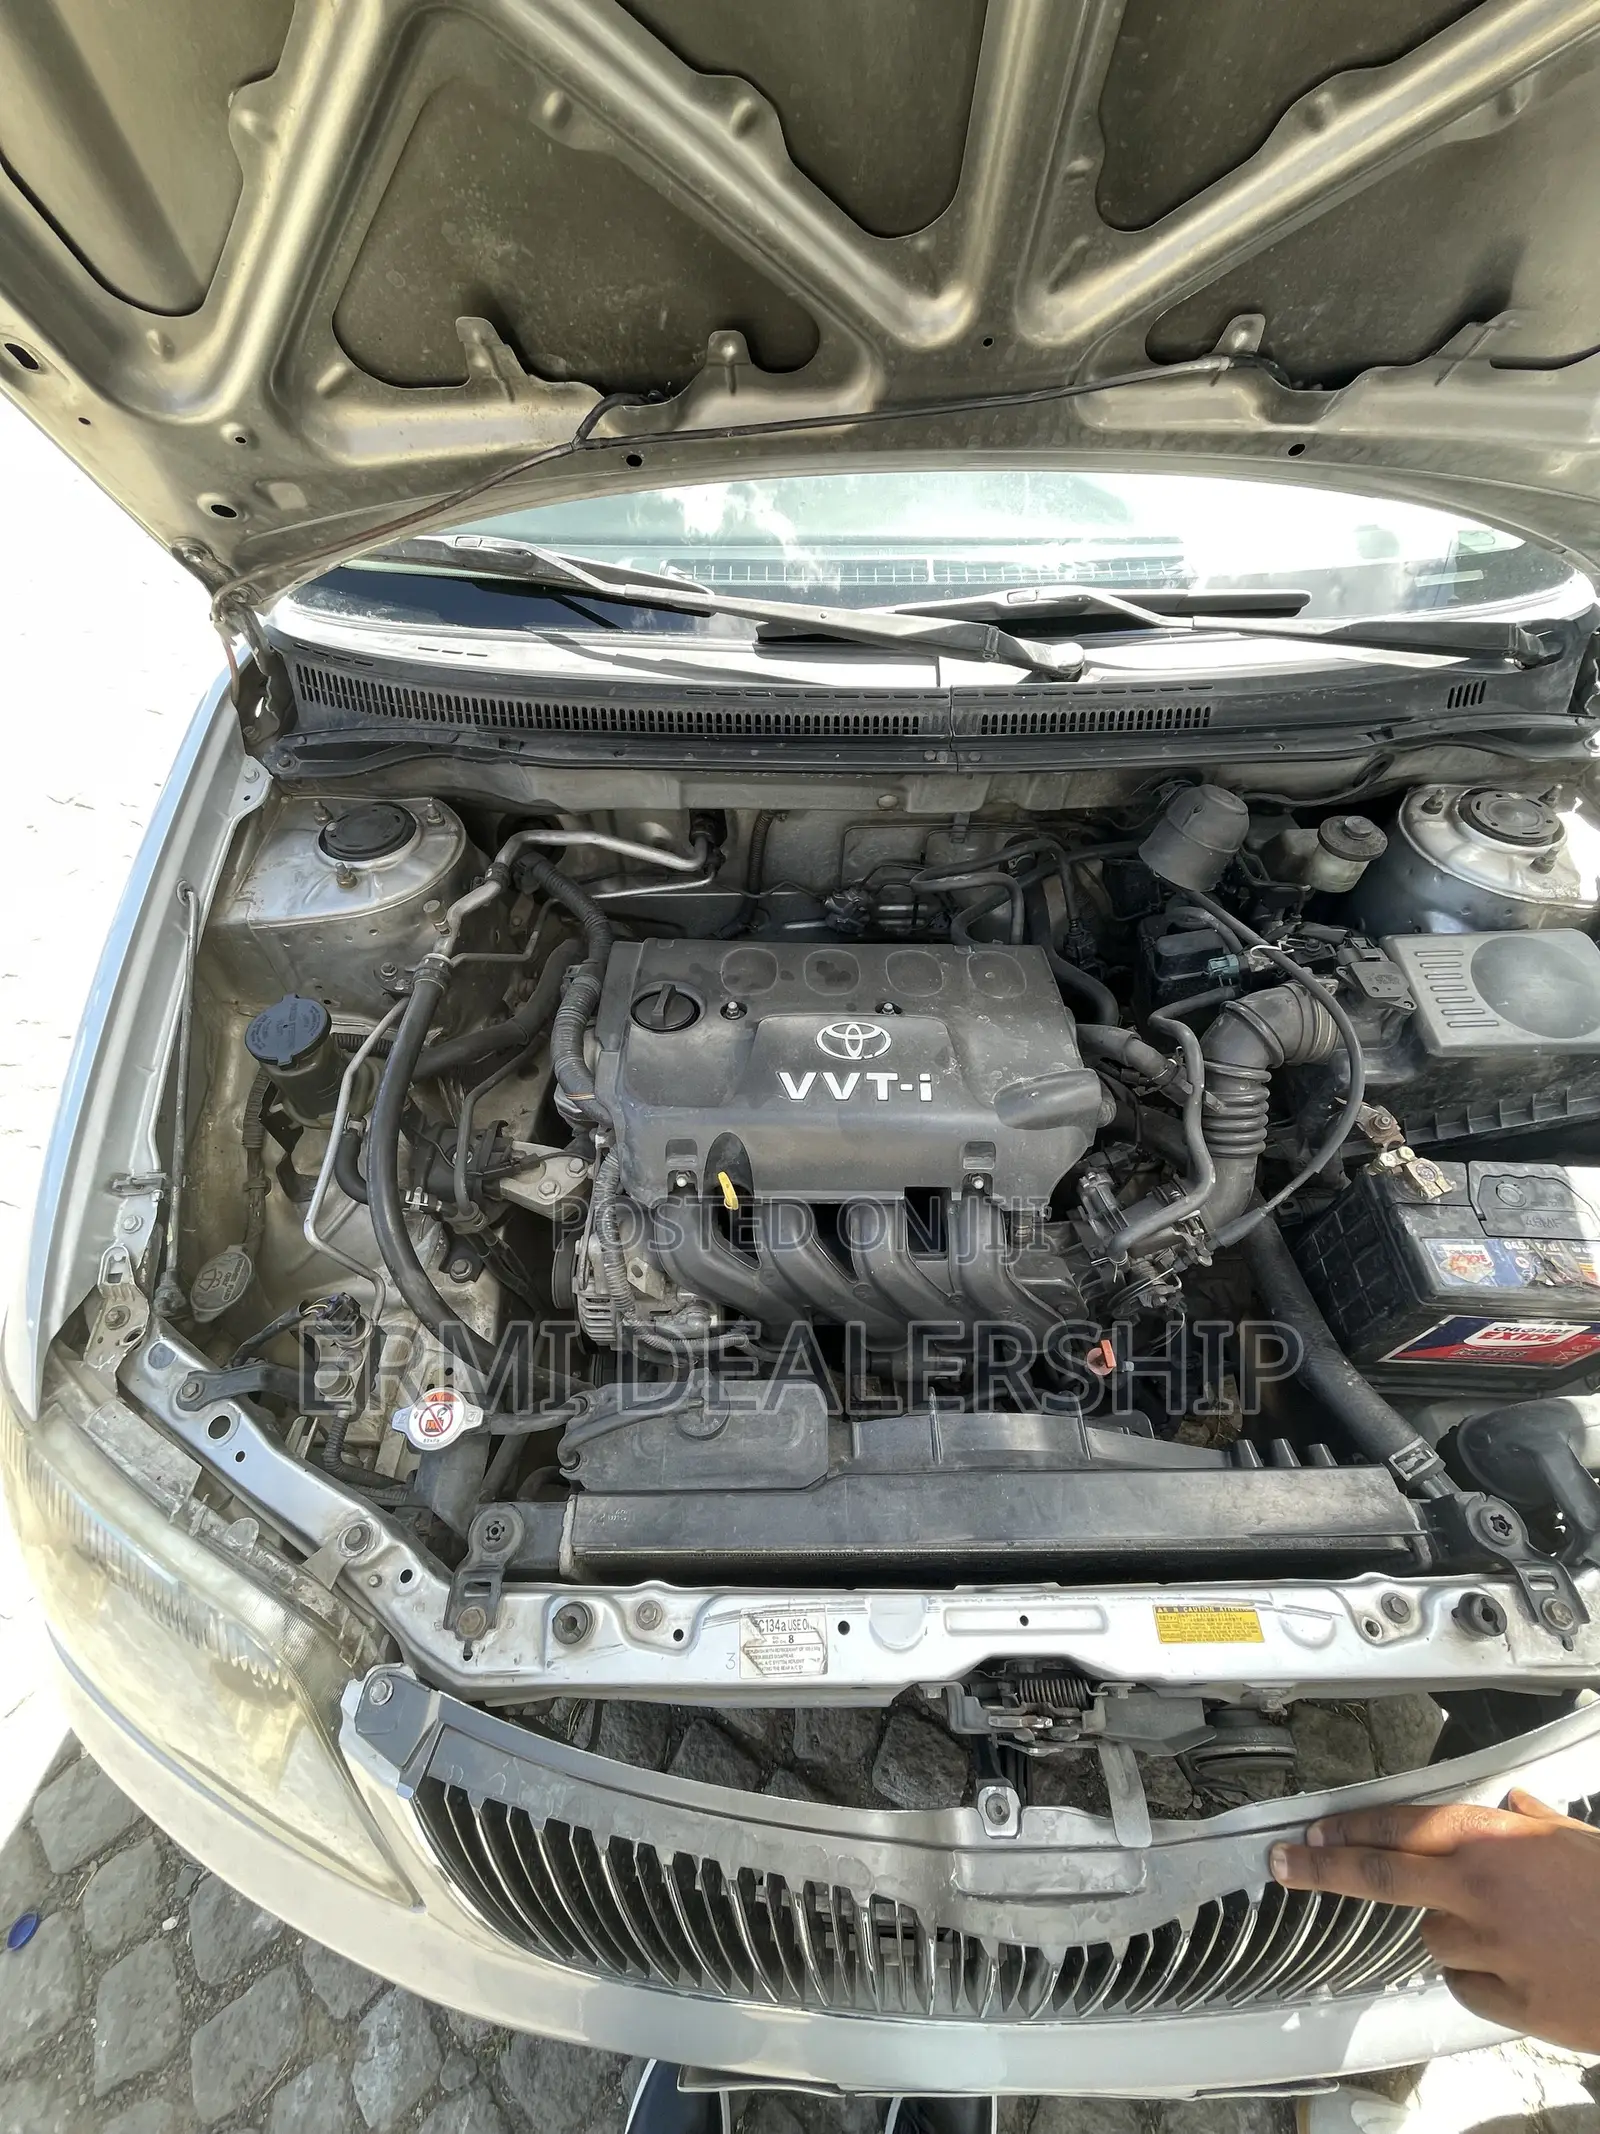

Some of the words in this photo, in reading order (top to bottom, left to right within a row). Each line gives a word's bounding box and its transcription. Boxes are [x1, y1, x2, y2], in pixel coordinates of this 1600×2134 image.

[777, 1072, 933, 1101] VVT-i
[1493, 1326, 1573, 1335] CHLORIDE
[1477, 1332, 1561, 1343] EXIDE
[788, 1619, 802, 1632] USE
[788, 1634, 795, 1644] 8
[725, 1652, 736, 1670] 3
